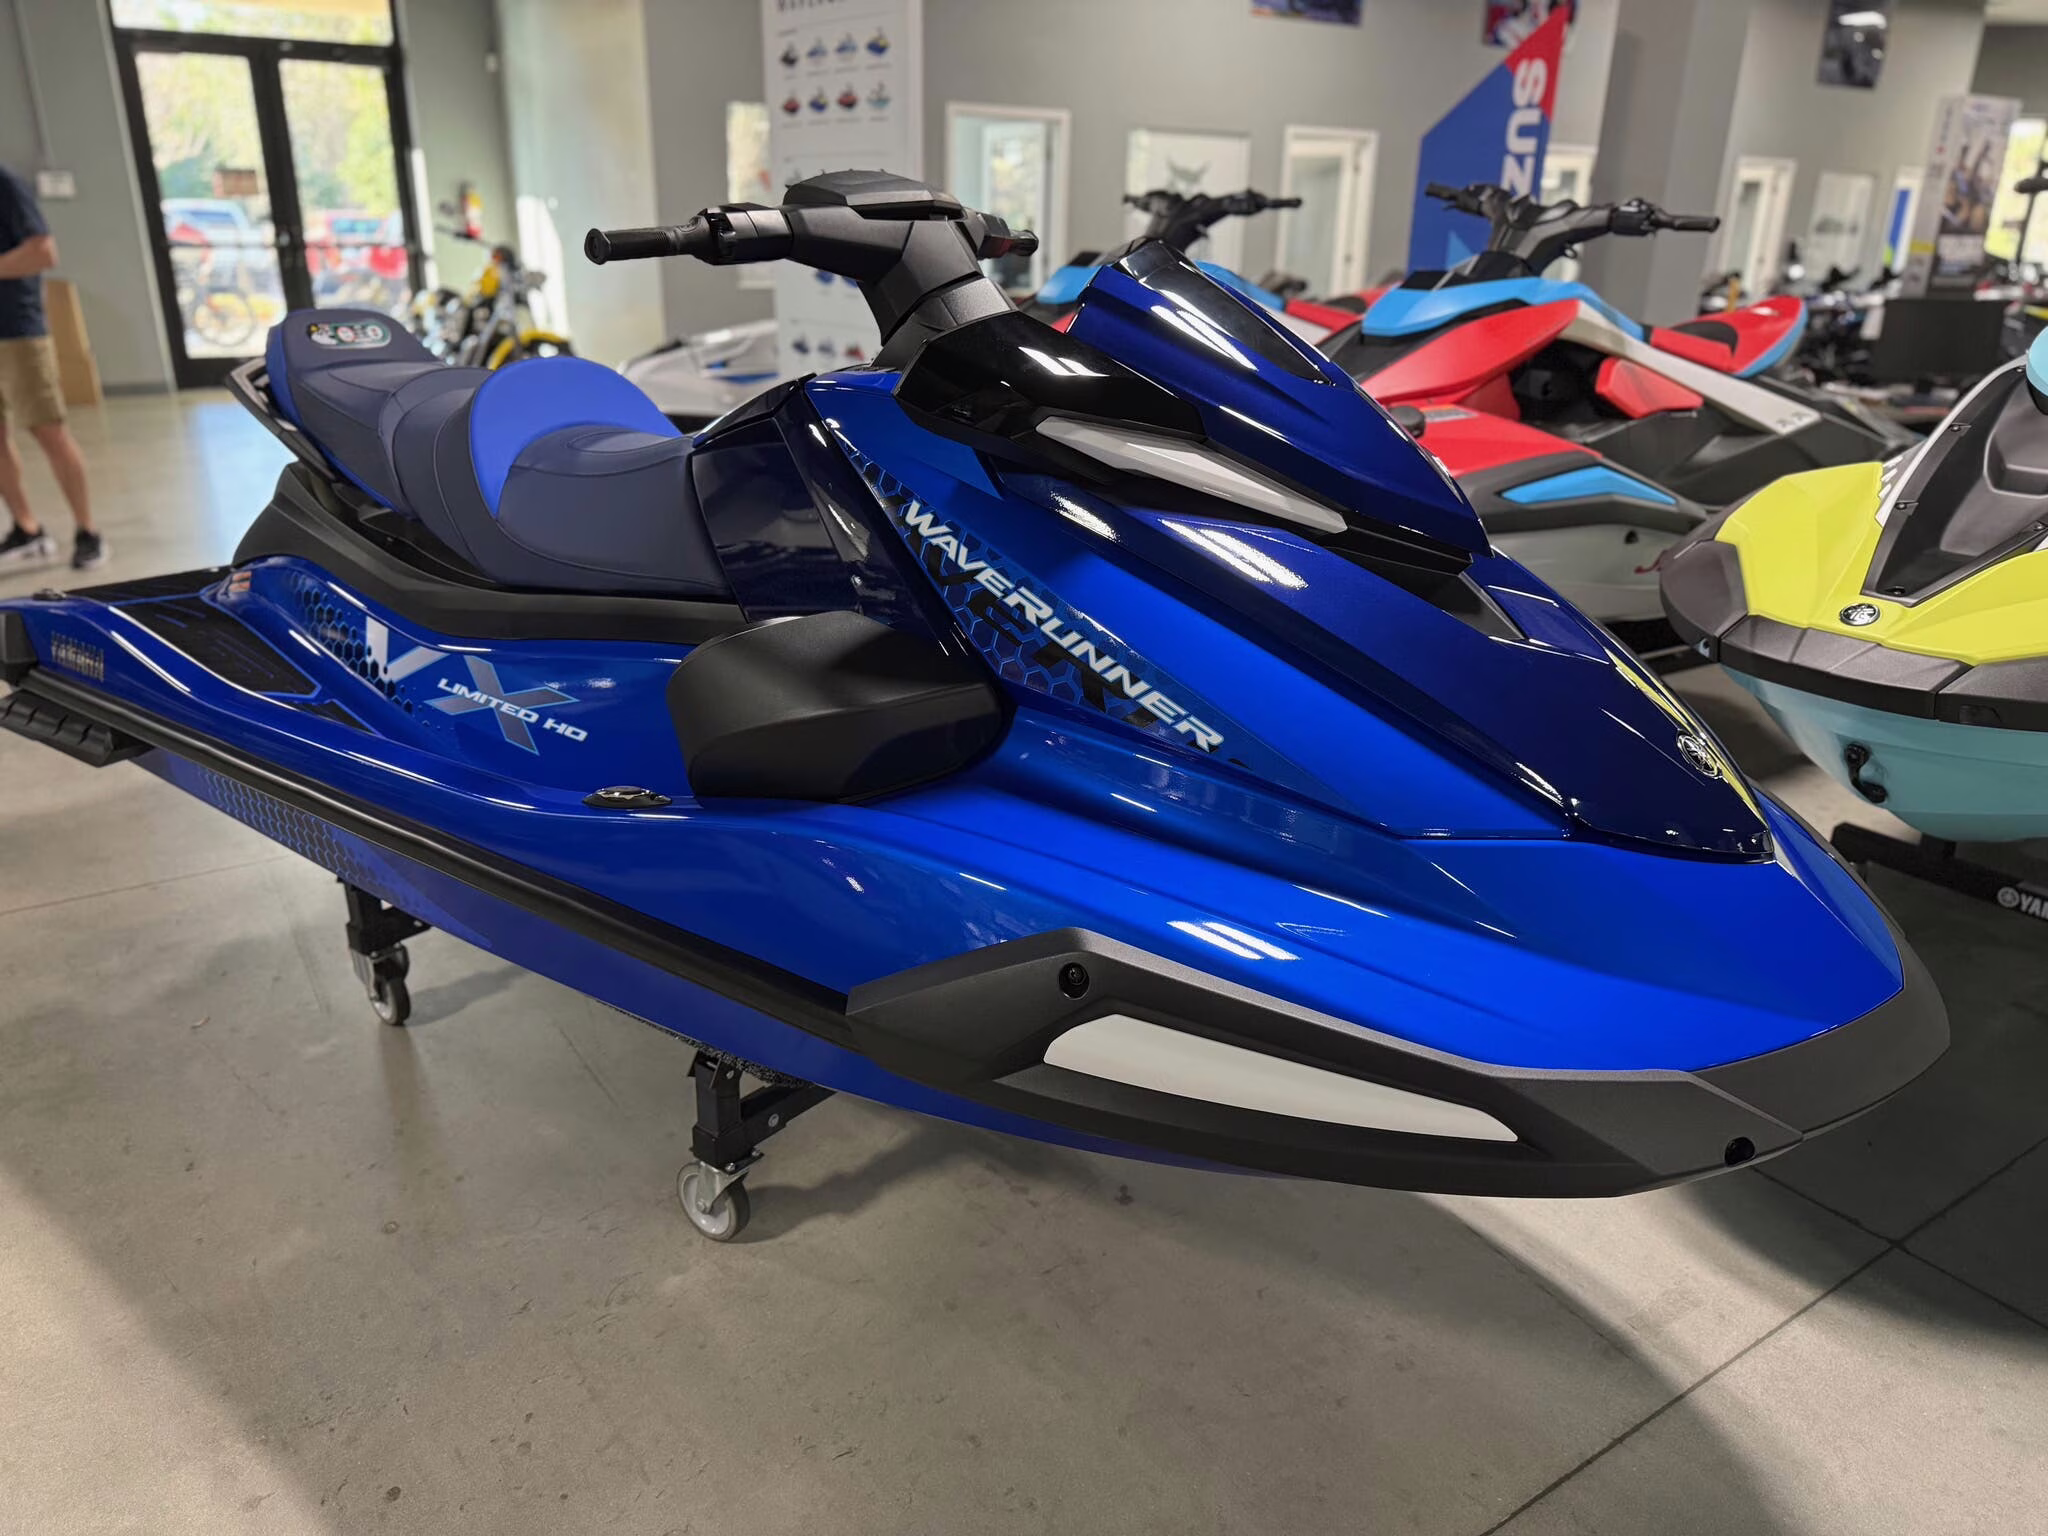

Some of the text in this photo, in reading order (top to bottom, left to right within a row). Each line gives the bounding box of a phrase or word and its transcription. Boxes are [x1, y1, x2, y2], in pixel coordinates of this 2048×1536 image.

[902, 499, 1225, 753] WAVERUNNER
[437, 677, 588, 742] LIMITED HO
